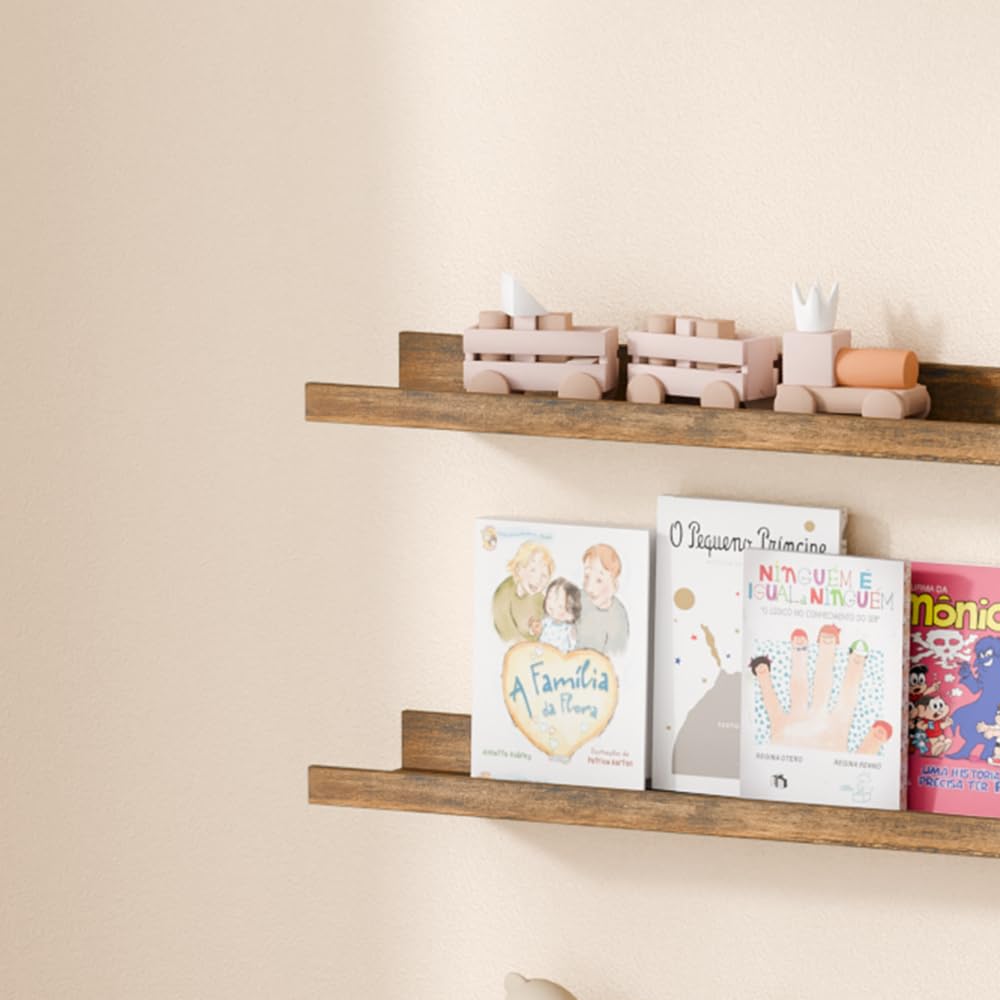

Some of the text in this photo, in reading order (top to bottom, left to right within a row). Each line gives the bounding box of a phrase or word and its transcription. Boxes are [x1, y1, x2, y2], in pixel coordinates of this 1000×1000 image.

[670, 520, 683, 548] O
[748, 582, 800, 603] IGUAL
[509, 659, 609, 718] A Família
[542, 692, 598, 719] da Flora
[922, 766, 947, 776] UMA
[968, 780, 988, 791] TER
